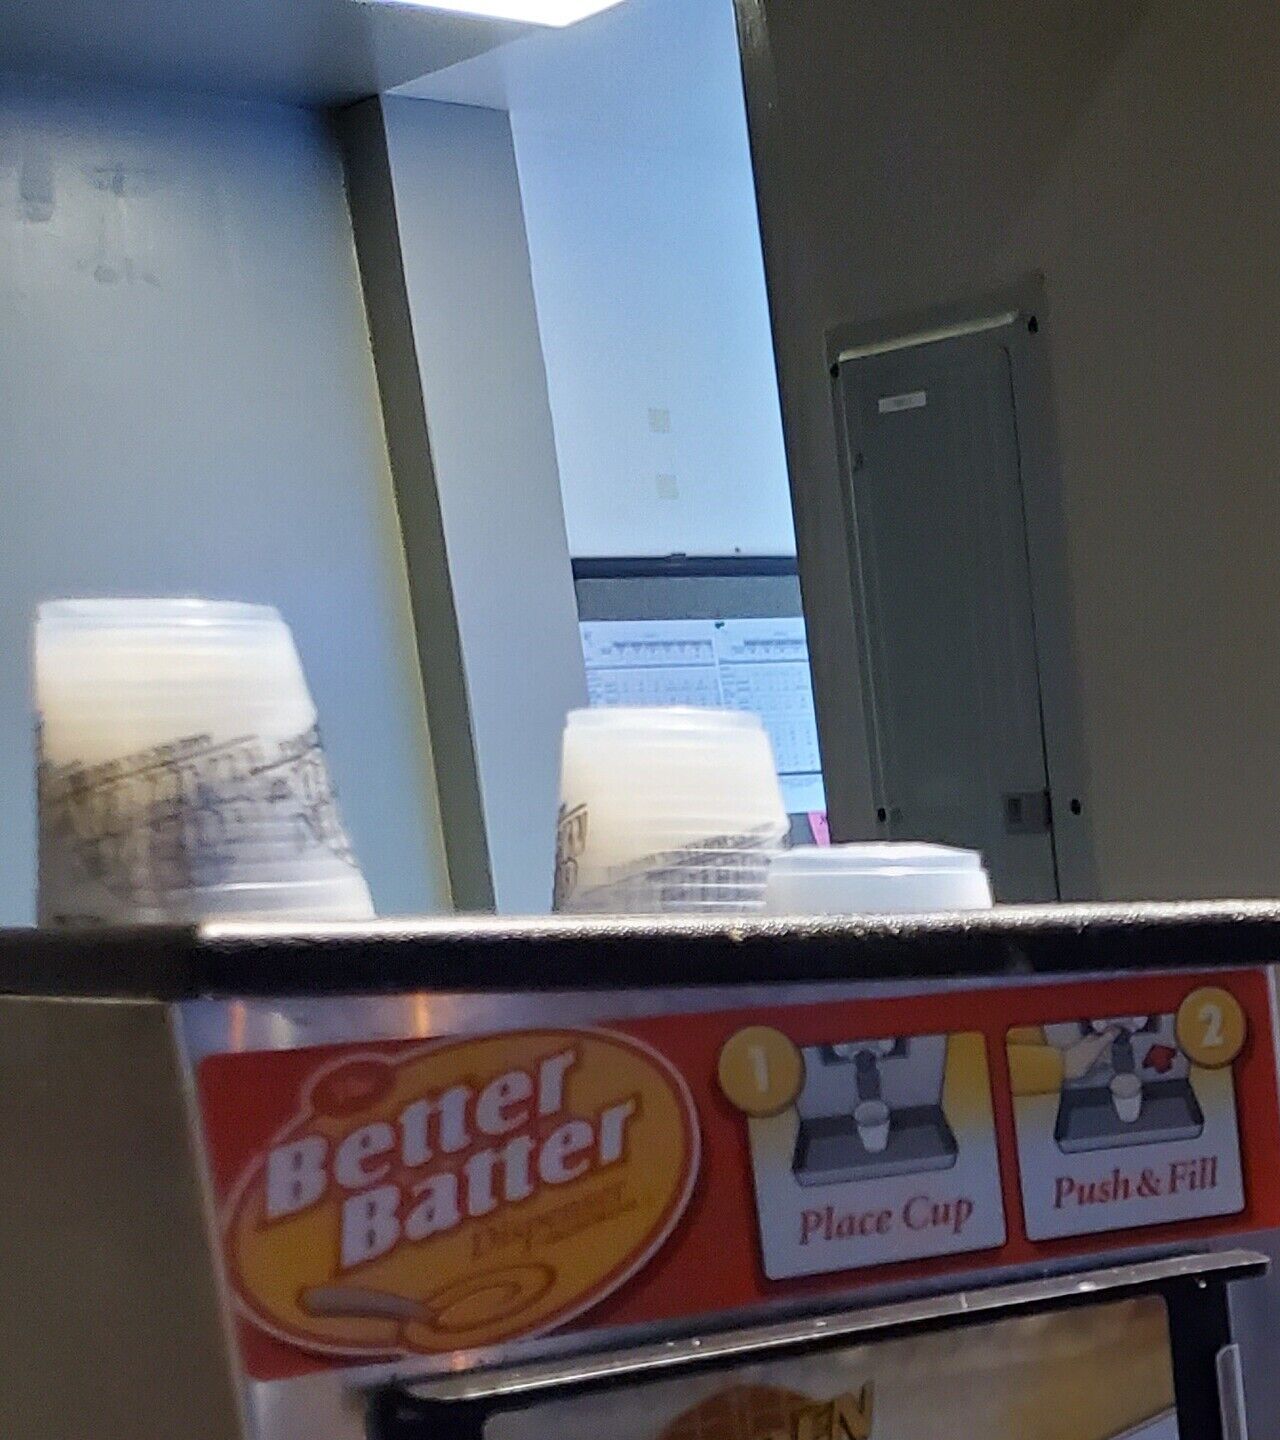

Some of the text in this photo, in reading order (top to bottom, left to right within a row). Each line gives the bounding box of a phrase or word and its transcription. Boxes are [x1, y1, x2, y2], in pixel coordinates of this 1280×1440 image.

[1197, 1003, 1224, 1048] 2
[747, 1045, 770, 1093] 1
[264, 1048, 580, 1220] Better
[340, 1101, 638, 1270] Batter
[1053, 1155, 1219, 1209] Push & Fill
[799, 1195, 974, 1246] Place Cup
